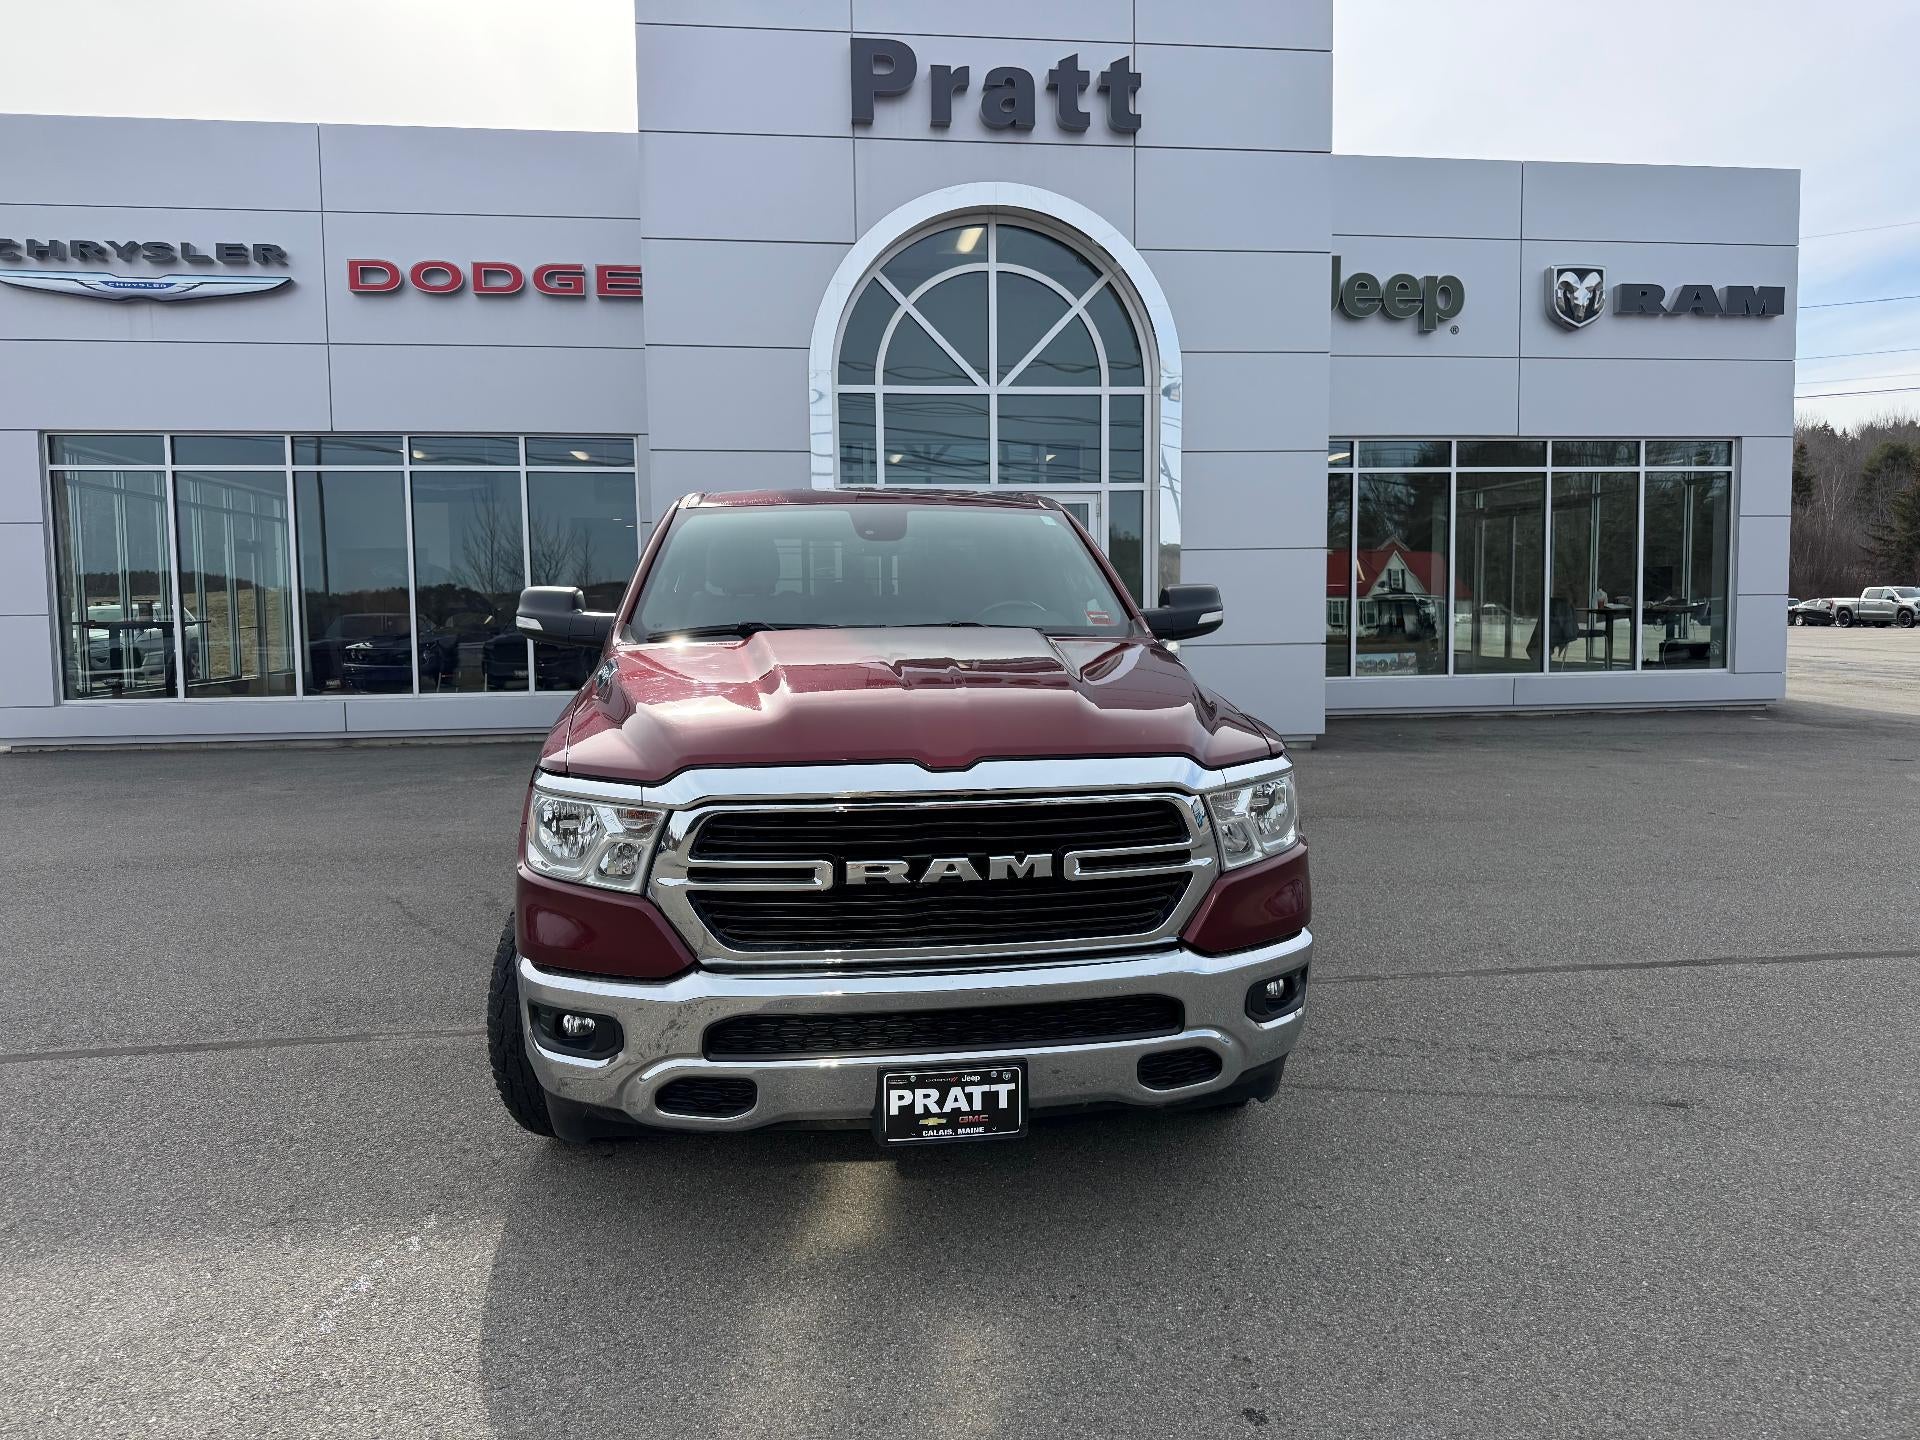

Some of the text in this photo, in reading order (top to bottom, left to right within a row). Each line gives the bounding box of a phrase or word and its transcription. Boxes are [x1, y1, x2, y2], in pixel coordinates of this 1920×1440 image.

[850, 37, 1141, 132] Pratt
[346, 258, 644, 297] DODGE
[1613, 283, 1786, 316] RAM
[845, 854, 1053, 885] RAM
[961, 1074, 981, 1083] Jeep
[889, 1082, 1016, 1116] PRATT
[922, 1126, 985, 1137] CALAIS, MAINE
[958, 1114, 989, 1124] GMC
